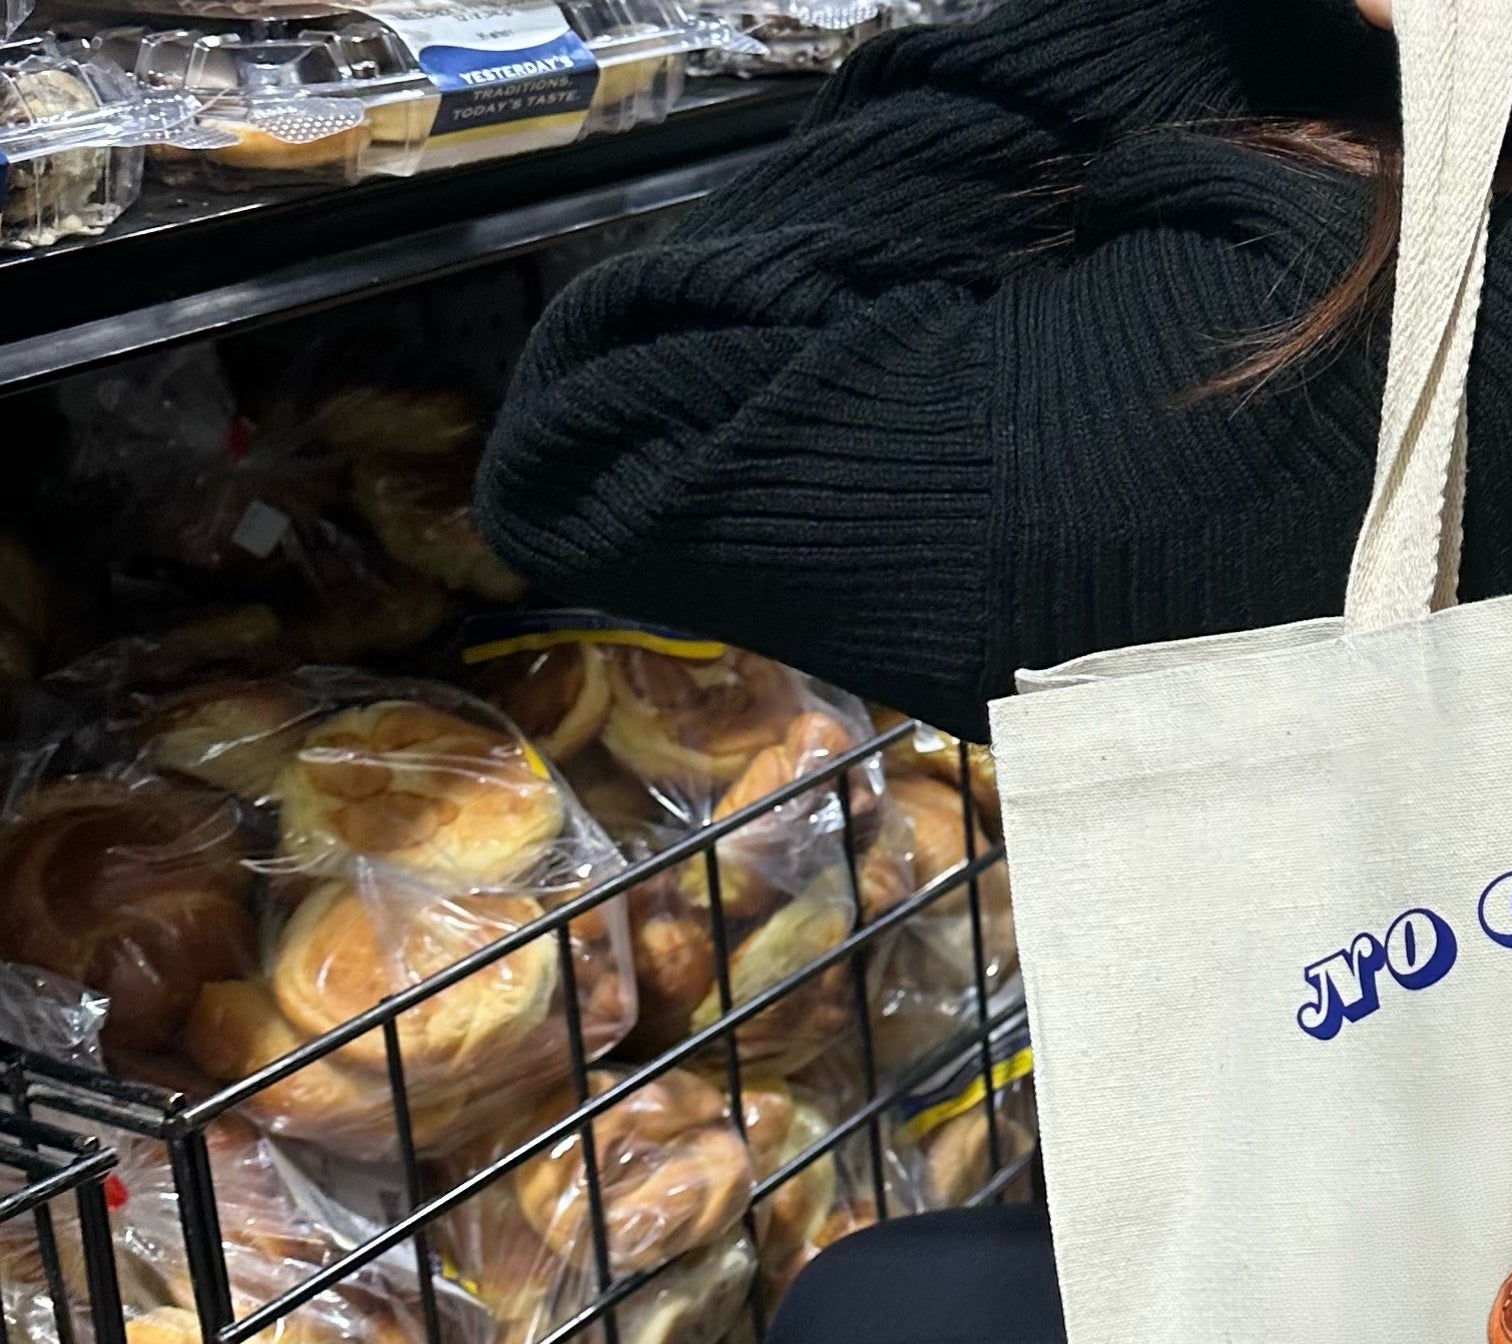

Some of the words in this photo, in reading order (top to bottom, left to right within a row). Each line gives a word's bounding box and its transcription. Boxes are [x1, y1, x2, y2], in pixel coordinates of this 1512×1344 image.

[459, 55, 574, 85] YESTERDAY'S
[453, 98, 522, 121] TODAY'S
[527, 89, 582, 111] TASTE.
[1297, 908, 1457, 1041] NO
